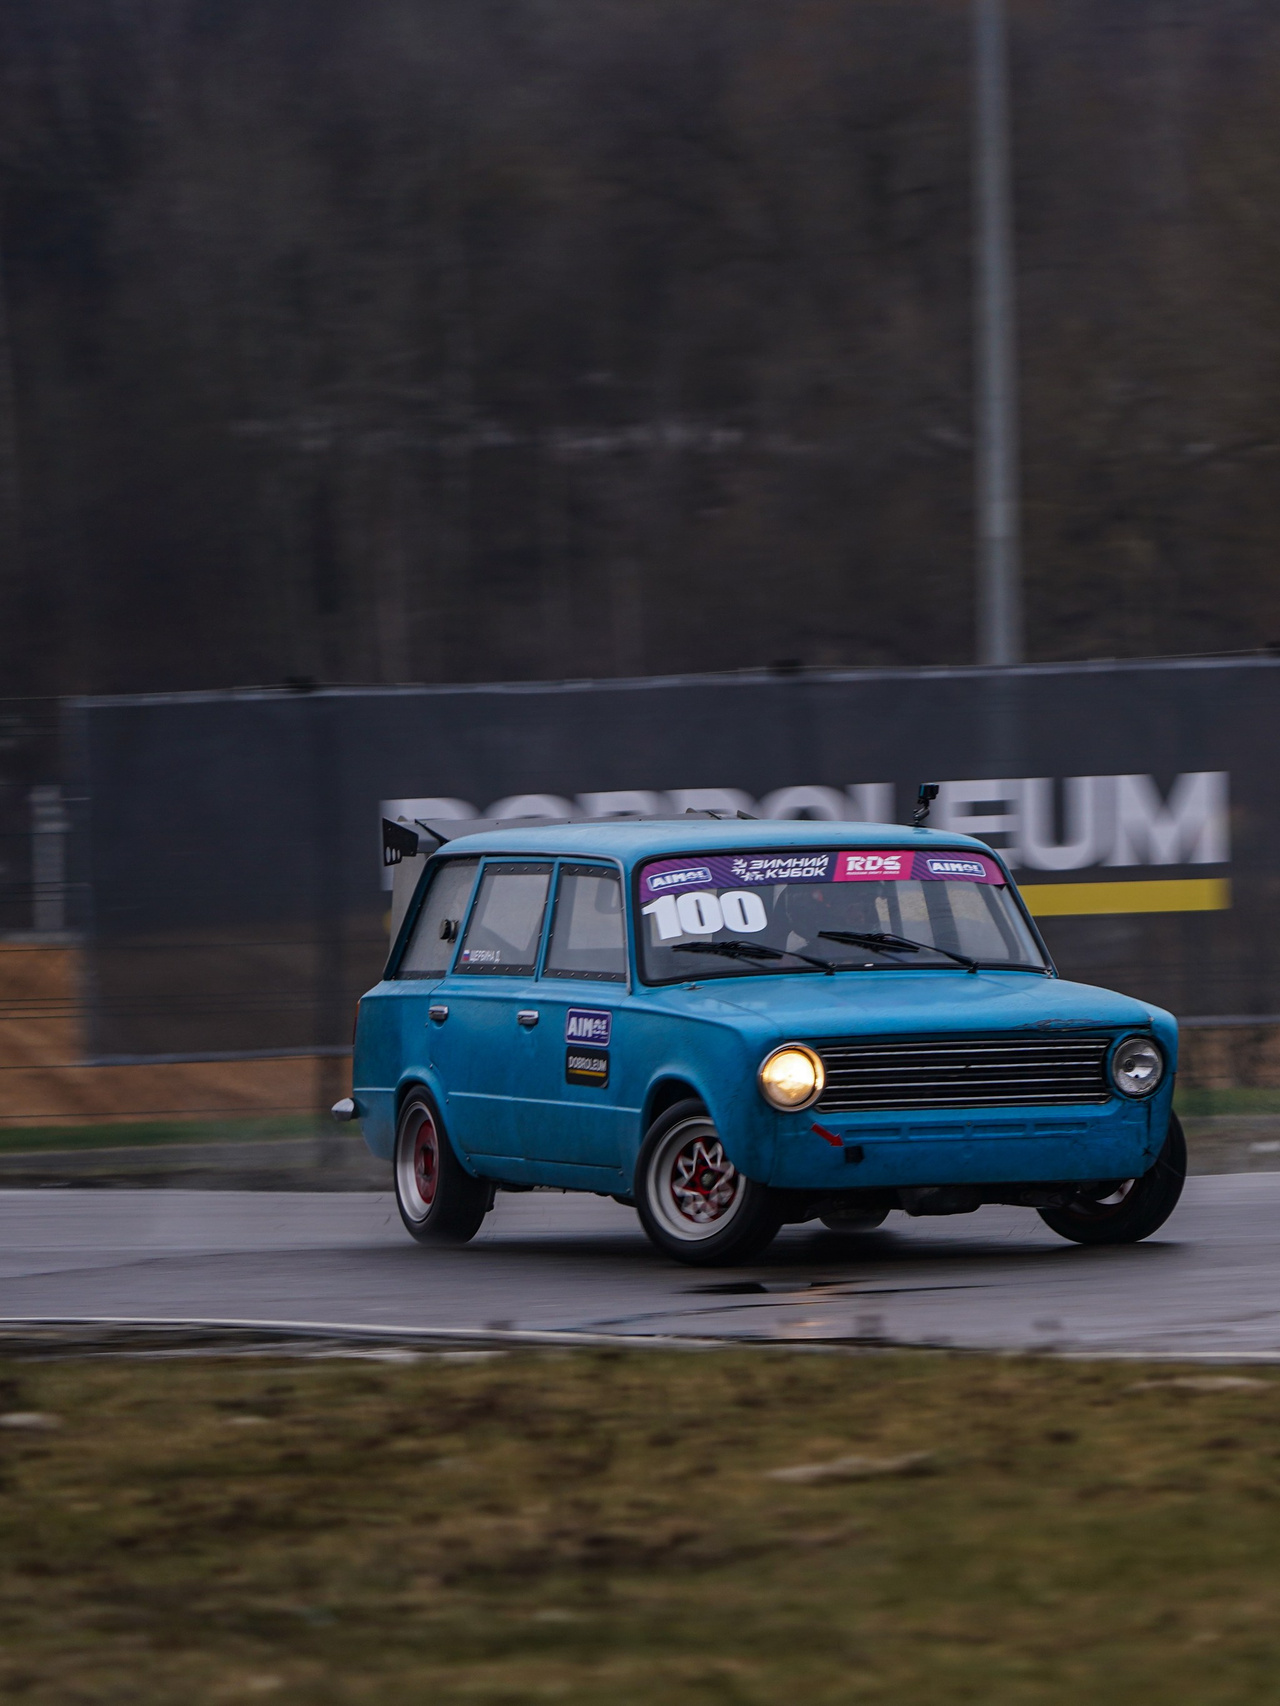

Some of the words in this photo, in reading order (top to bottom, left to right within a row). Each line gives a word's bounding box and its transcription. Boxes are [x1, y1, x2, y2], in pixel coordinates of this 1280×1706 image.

[750, 855, 829, 869] ЗИМНИЙ
[846, 856, 902, 871] RDS
[932, 862, 983, 874] AIMOL
[652, 869, 708, 888] AIMOL
[766, 867, 826, 879] КУБОК
[642, 890, 768, 941] 100
[568, 1055, 607, 1072] DOBROLEUM
